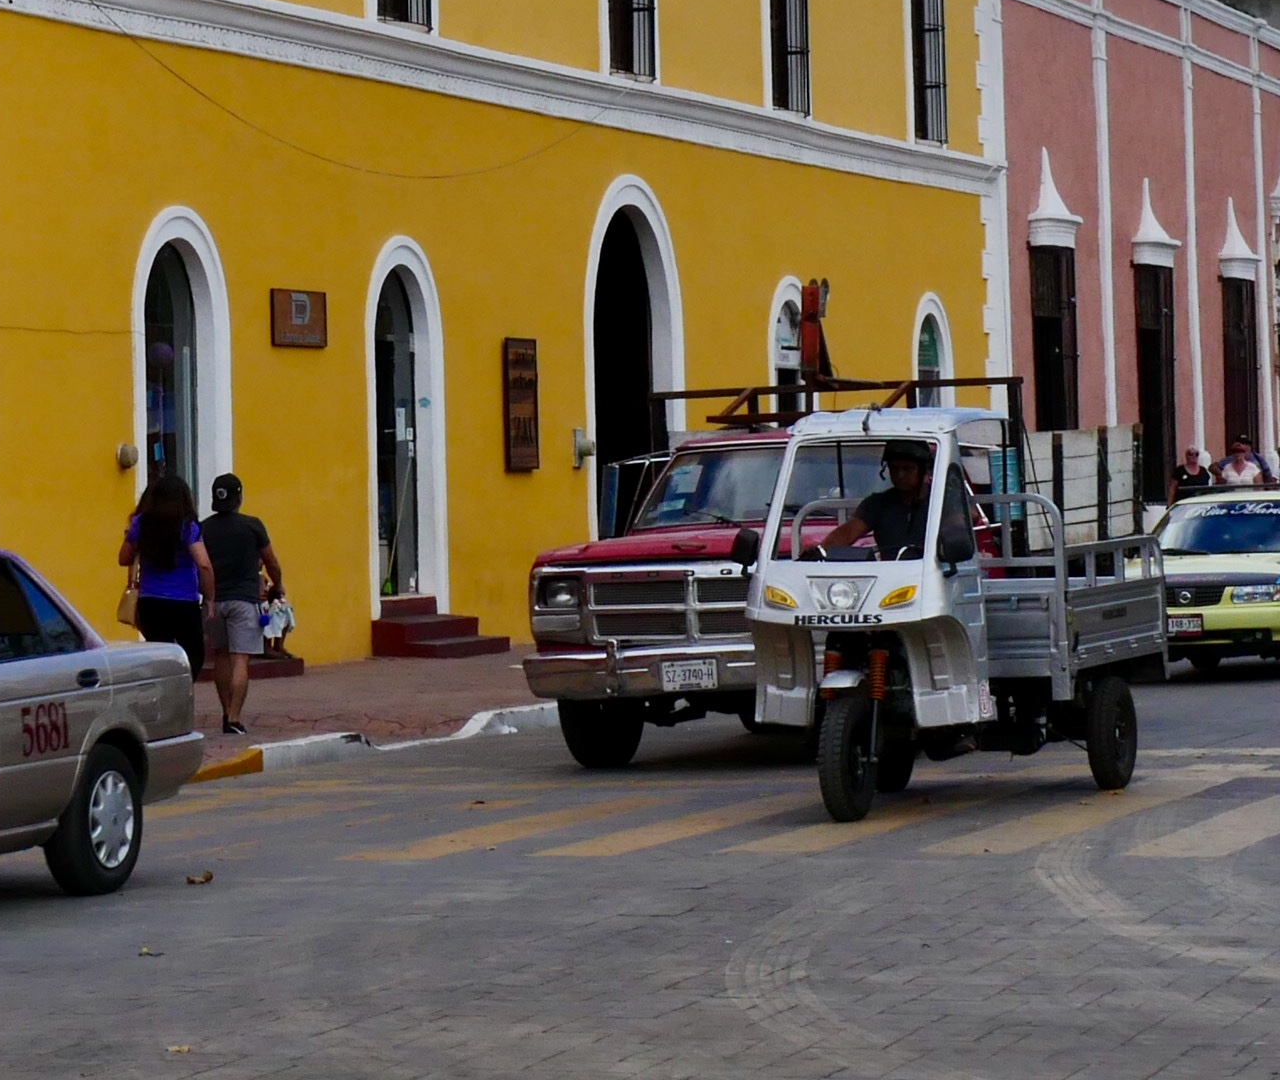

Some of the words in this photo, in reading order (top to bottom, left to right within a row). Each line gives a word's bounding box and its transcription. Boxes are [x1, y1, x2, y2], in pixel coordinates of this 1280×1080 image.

[794, 614, 883, 625] HERCULES
[665, 667, 714, 683] SZ-3740-H
[21, 702, 69, 758] 5681
